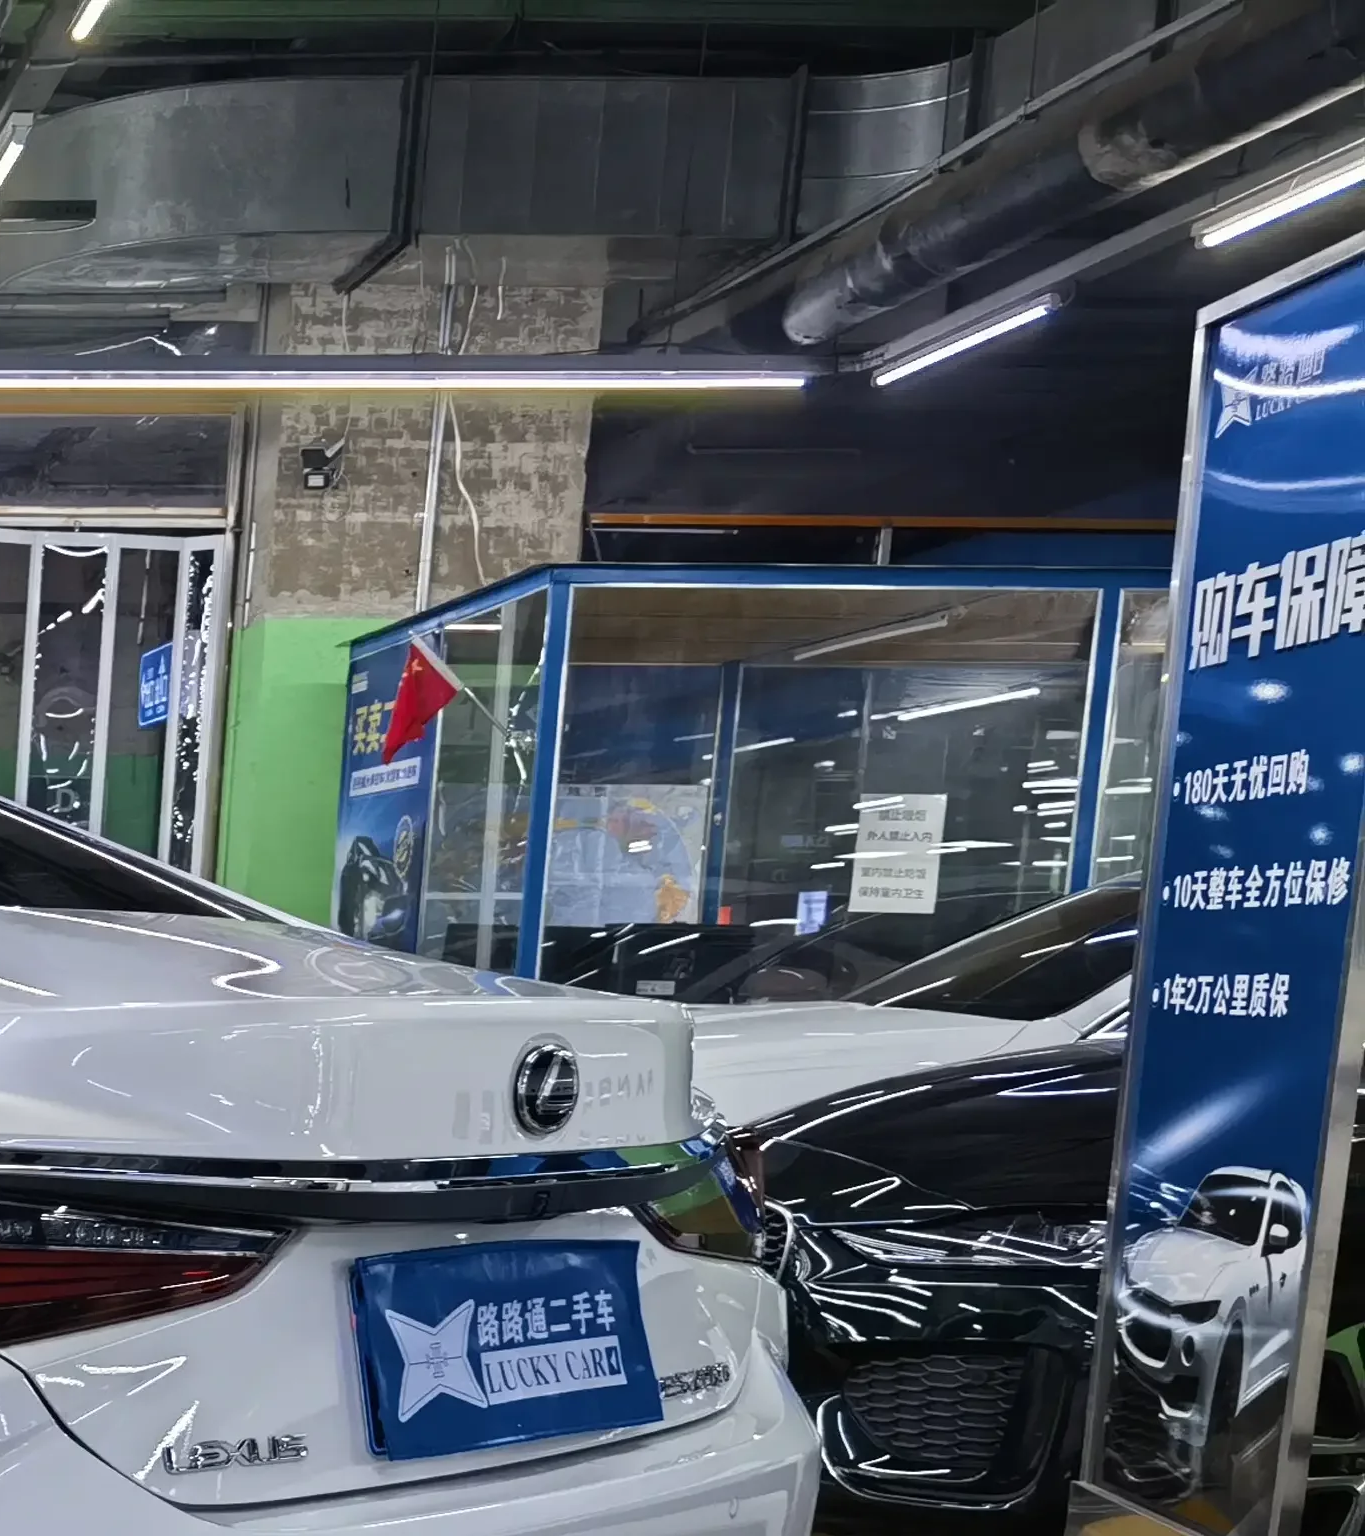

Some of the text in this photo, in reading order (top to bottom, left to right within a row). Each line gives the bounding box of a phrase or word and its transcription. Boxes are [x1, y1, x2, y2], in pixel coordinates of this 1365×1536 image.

[1188, 530, 1365, 671] 购车保障
[1184, 749, 1310, 805] 180天无忧回购
[1173, 856, 1351, 911] 10天整车全方位保修
[1163, 972, 1291, 1018] 1年2万公里质保
[476, 1289, 616, 1347] 路路通二手车
[484, 1353, 561, 1394] LUCKY
[162, 1434, 309, 1475] LEXUS
